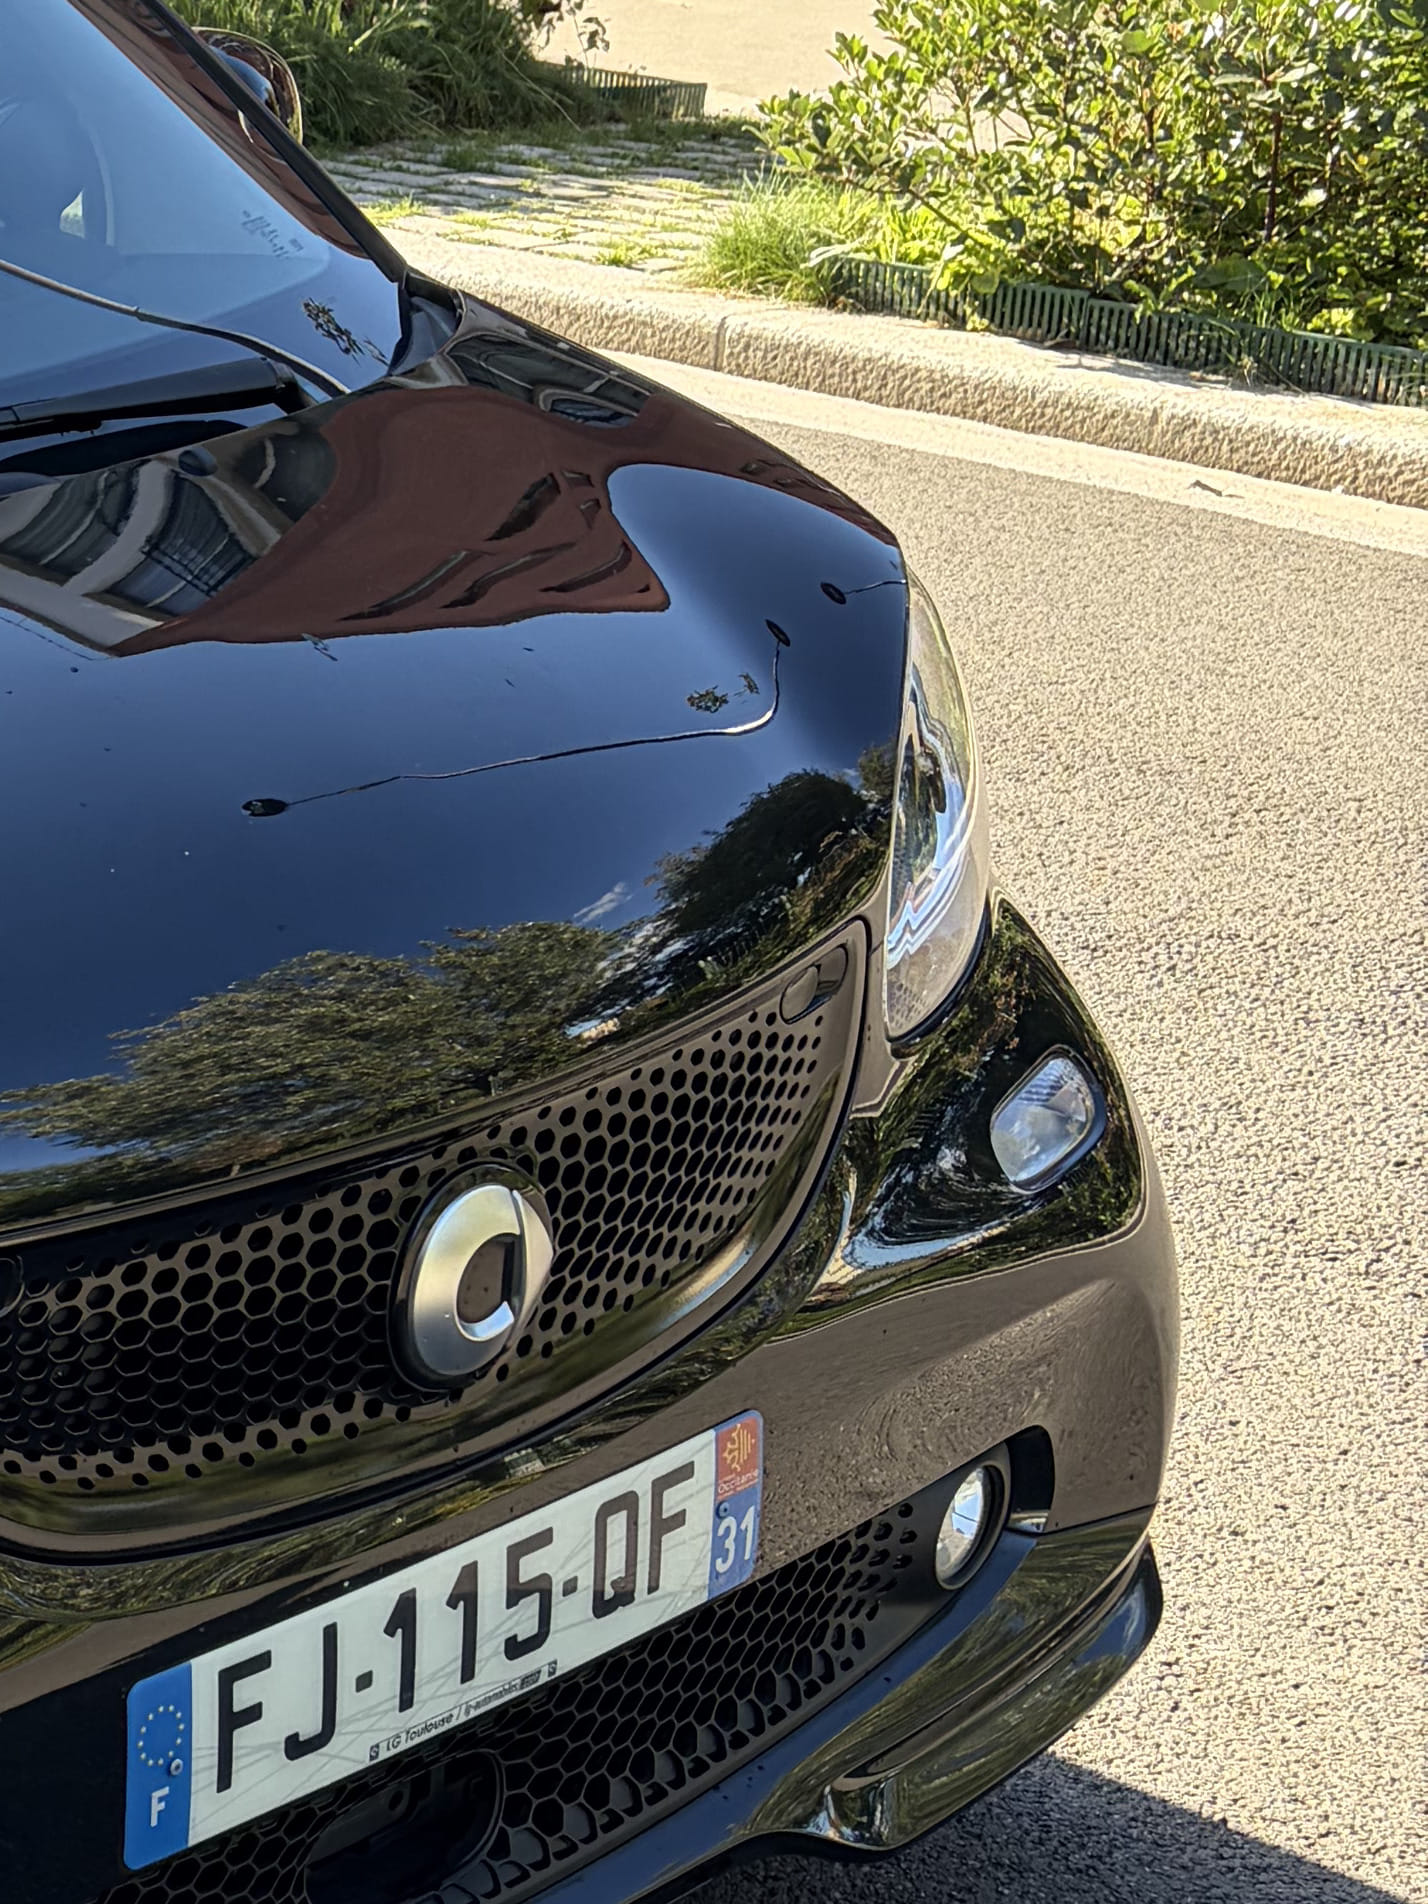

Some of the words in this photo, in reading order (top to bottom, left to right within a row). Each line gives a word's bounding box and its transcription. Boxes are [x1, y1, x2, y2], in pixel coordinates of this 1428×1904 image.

[715, 1505, 755, 1574] 31
[216, 1460, 696, 1794] FJ-115-QF
[386, 1736, 402, 1753] LG
[405, 1710, 454, 1744] Toulouse
[148, 1787, 170, 1828] F
